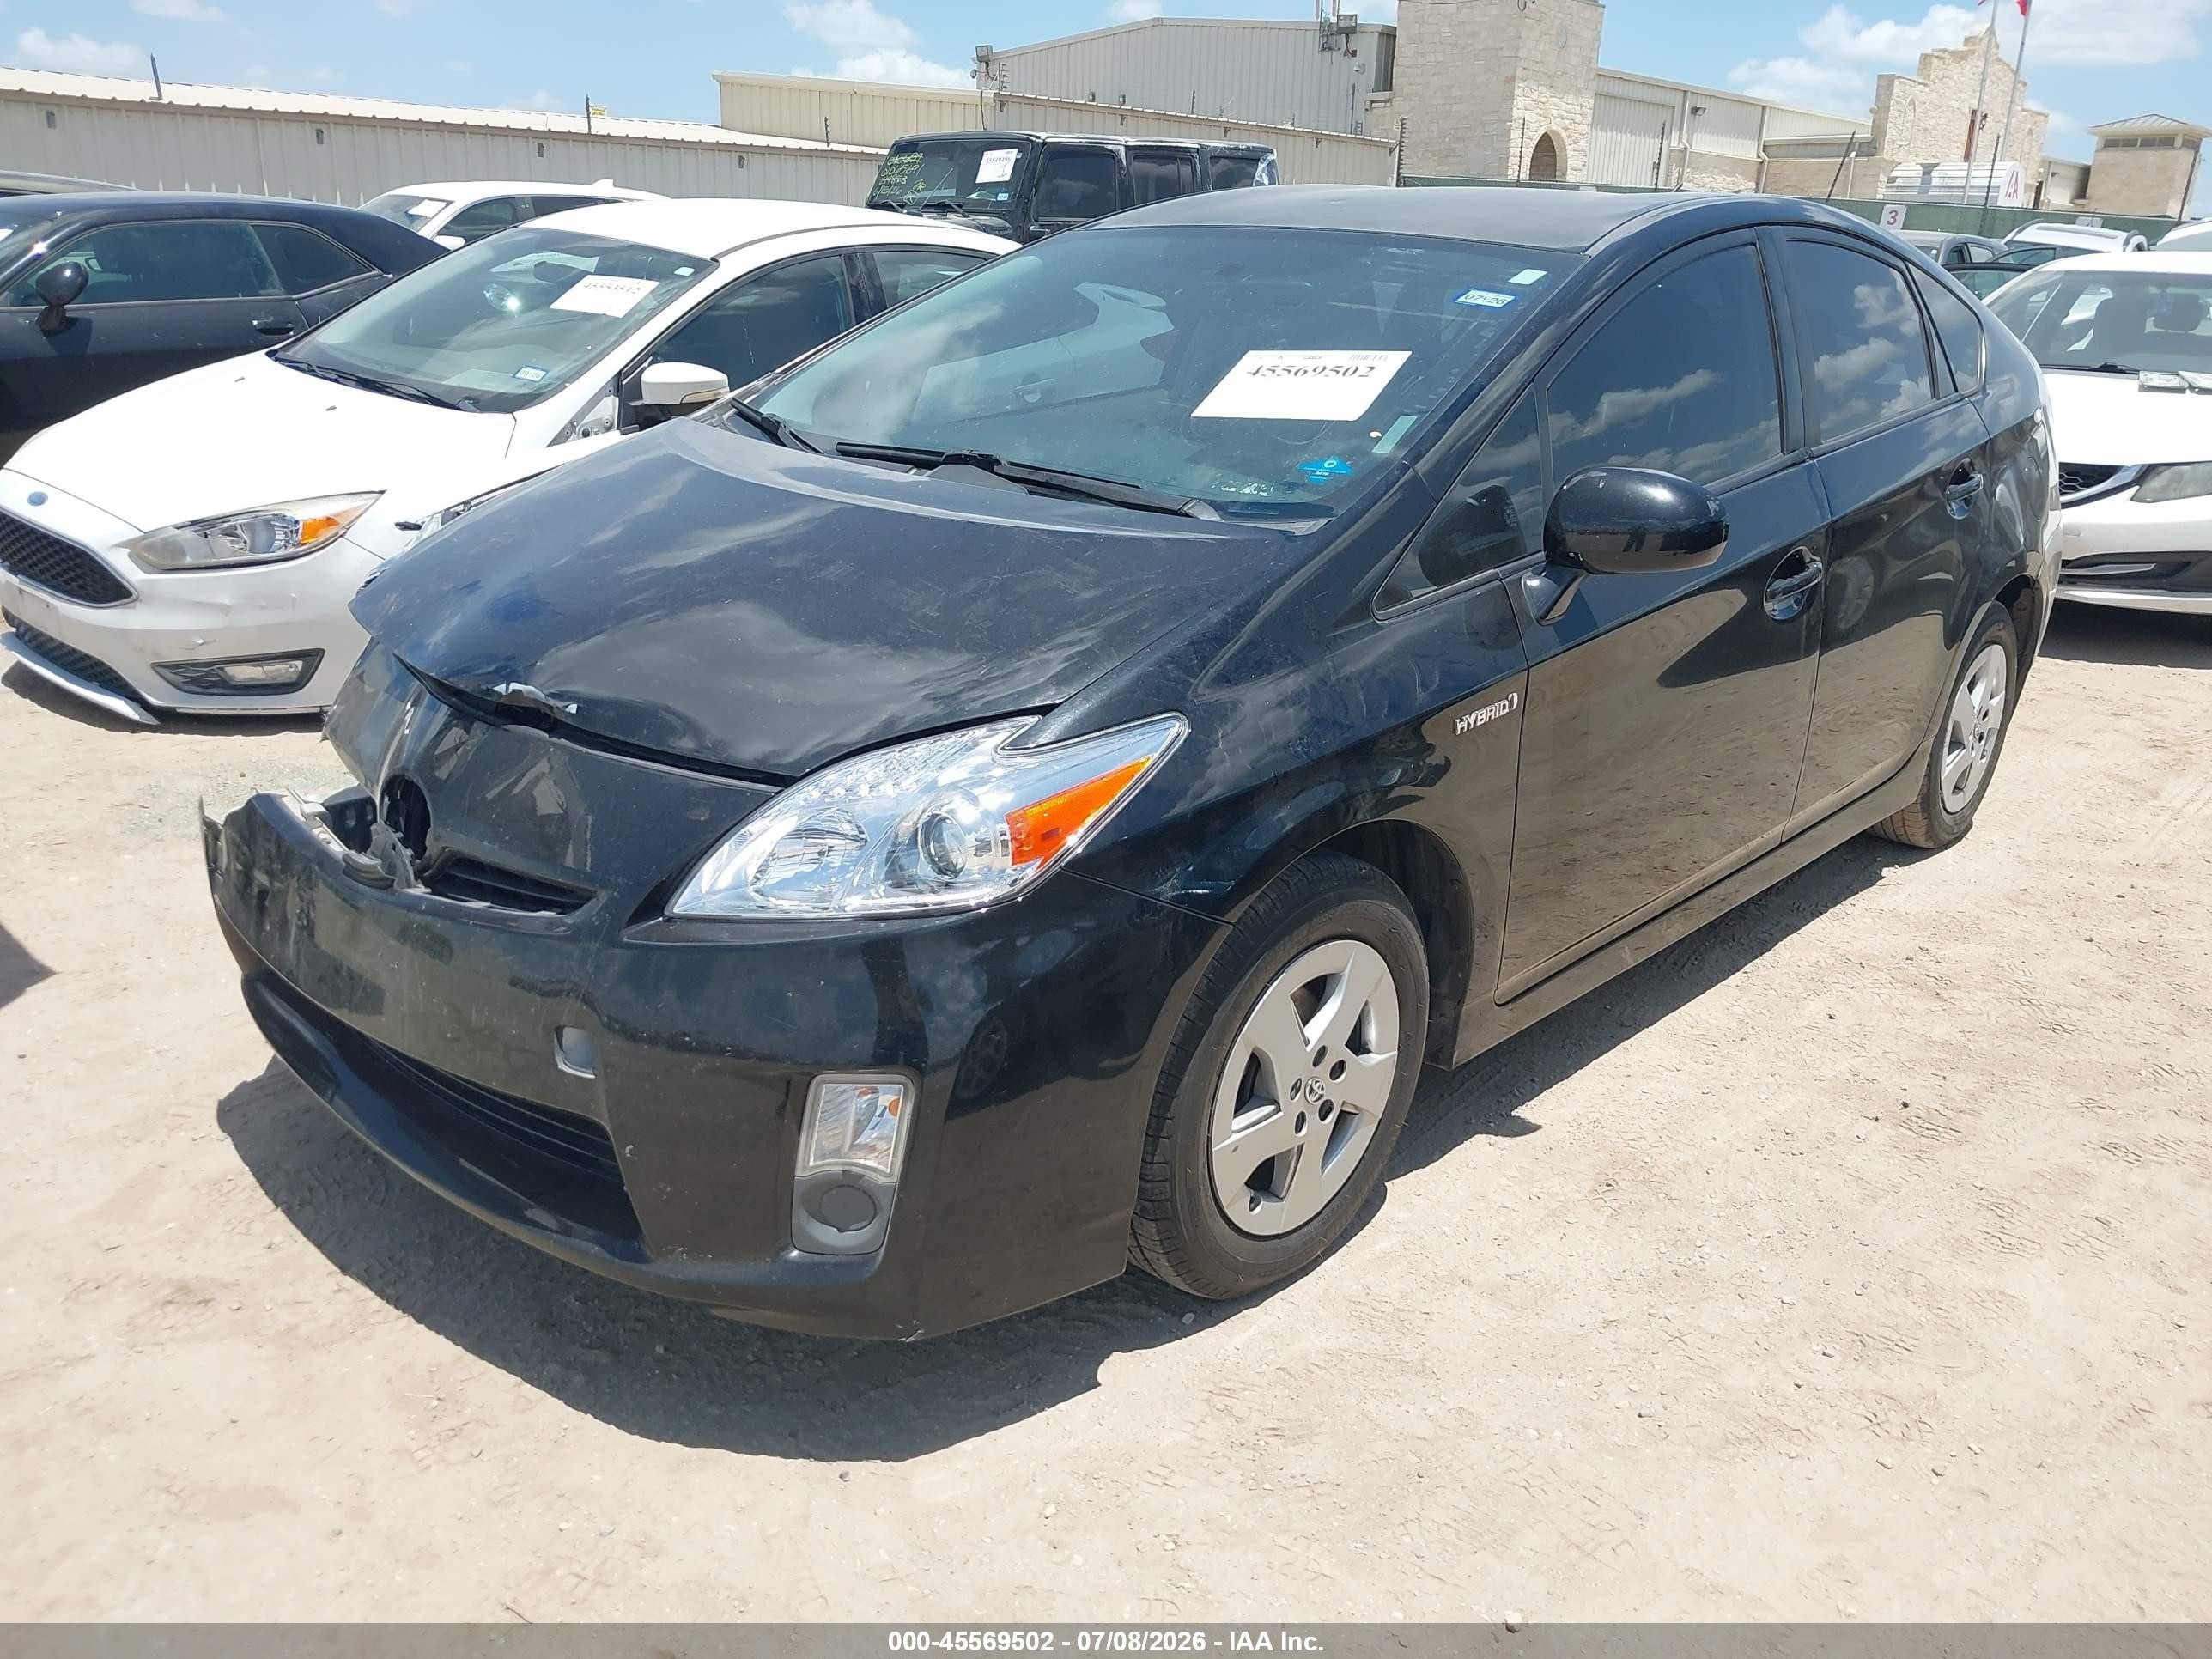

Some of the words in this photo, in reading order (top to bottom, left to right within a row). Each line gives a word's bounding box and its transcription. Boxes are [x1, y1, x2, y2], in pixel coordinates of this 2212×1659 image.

[1887, 210, 1899, 225] 3
[1247, 365, 1376, 377] 45569502
[1455, 692, 1519, 736] HYBRID
